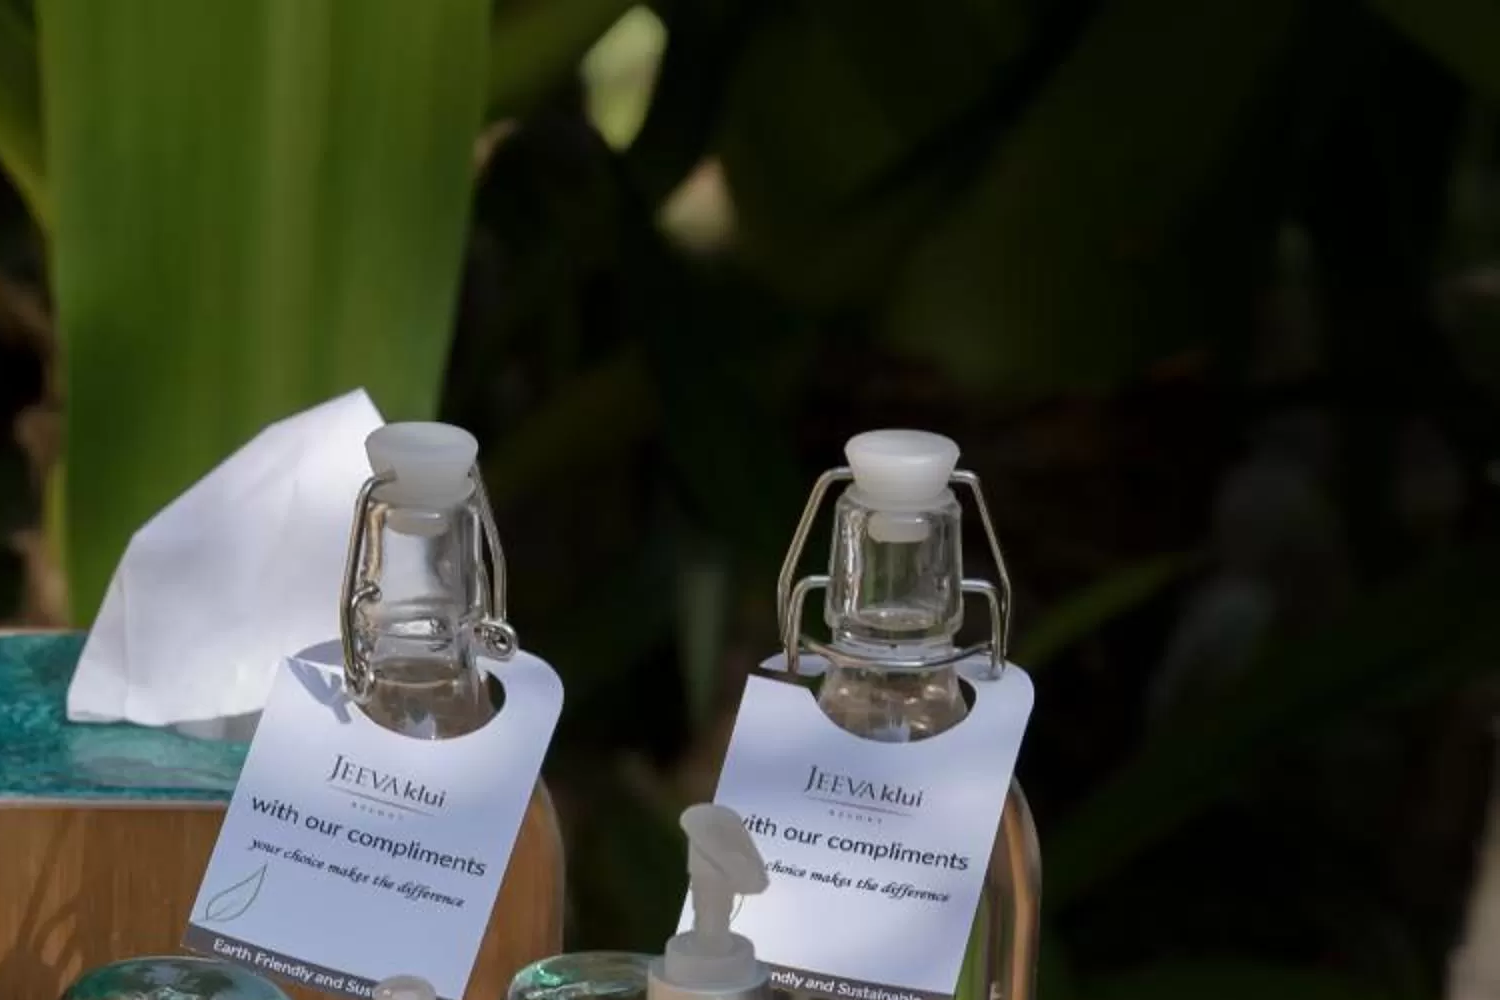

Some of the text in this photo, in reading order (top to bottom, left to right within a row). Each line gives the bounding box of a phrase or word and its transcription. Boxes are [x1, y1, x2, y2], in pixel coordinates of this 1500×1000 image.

[326, 754, 447, 808] JEEVA klui
[804, 764, 924, 808] JEEVA klui
[252, 796, 487, 877] with our compliments
[783, 826, 823, 845] our
[827, 834, 970, 871] compliments
[248, 838, 466, 908] your choice makes the difference
[810, 870, 852, 889] makes
[856, 877, 879, 892] the
[880, 881, 951, 902] difference
[213, 937, 372, 998] Earth Friendly and Sus
[771, 970, 802, 989] ndly
[805, 978, 835, 993] and
